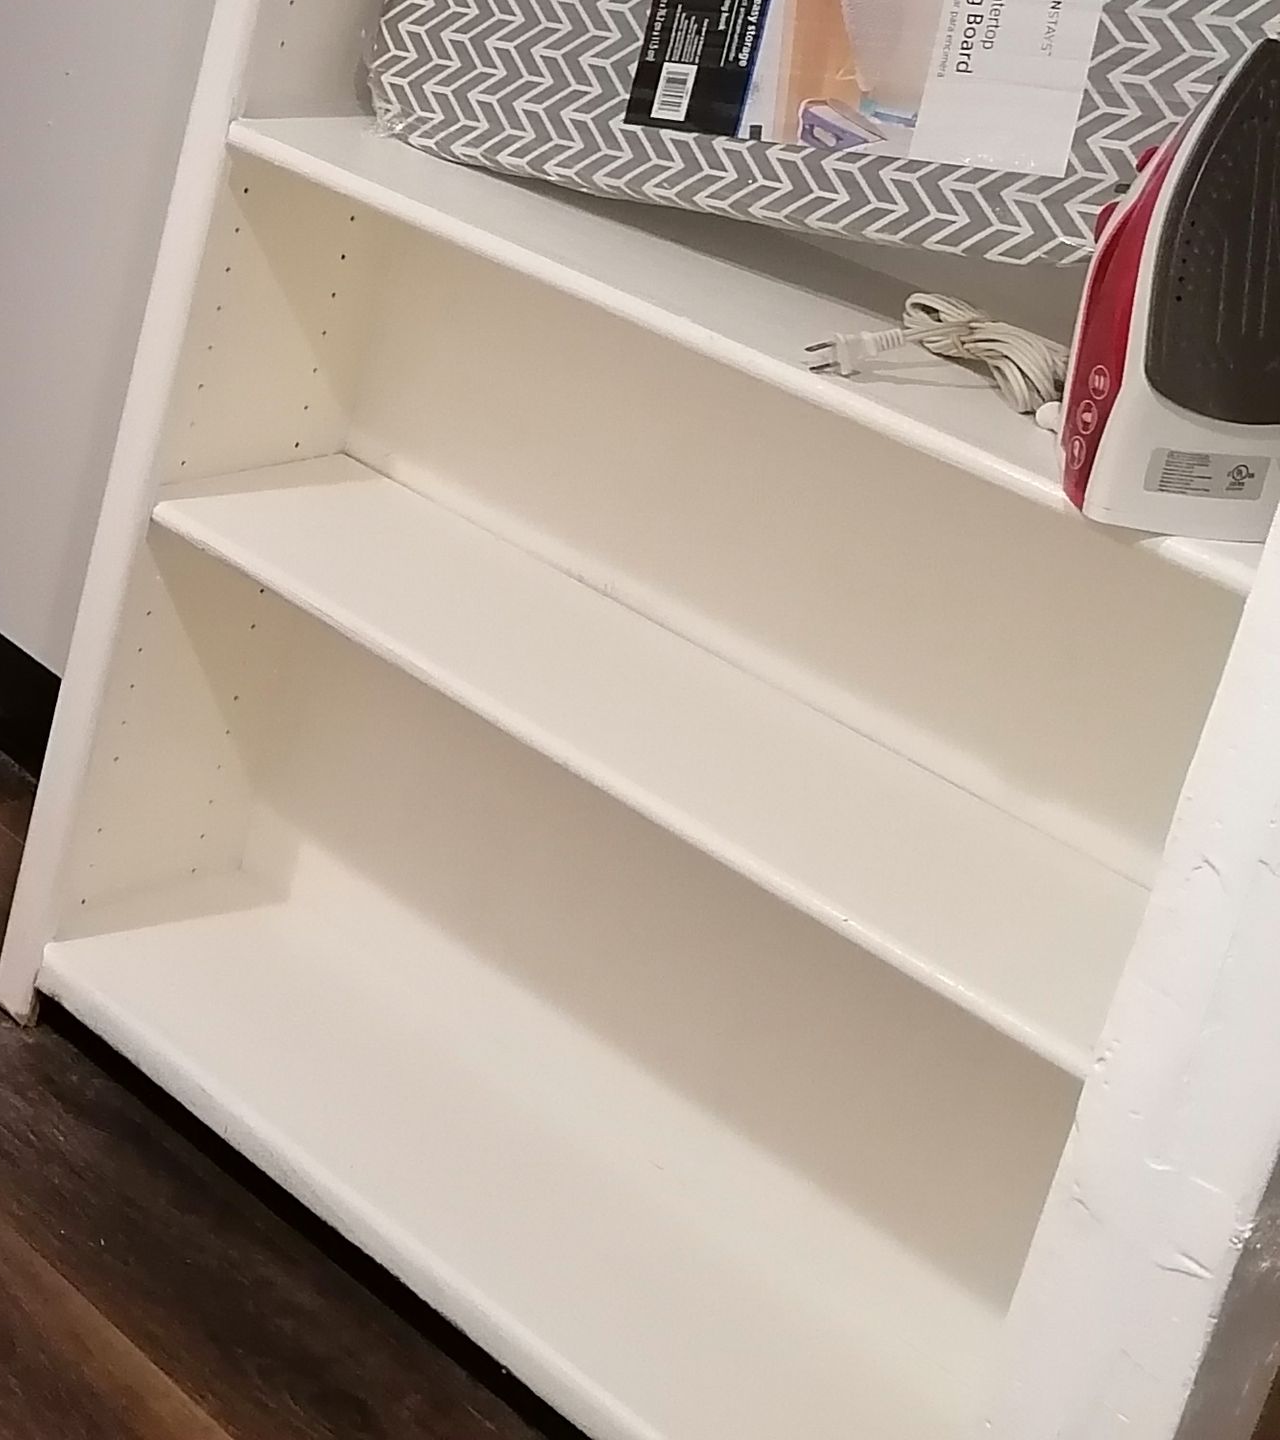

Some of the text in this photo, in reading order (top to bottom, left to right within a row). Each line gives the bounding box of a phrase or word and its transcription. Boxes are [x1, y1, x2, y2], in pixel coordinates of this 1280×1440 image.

[946, 11, 959, 32] para
[737, 25, 756, 66] storage
[936, 34, 953, 78] encimera
[955, 13, 984, 75] Board
